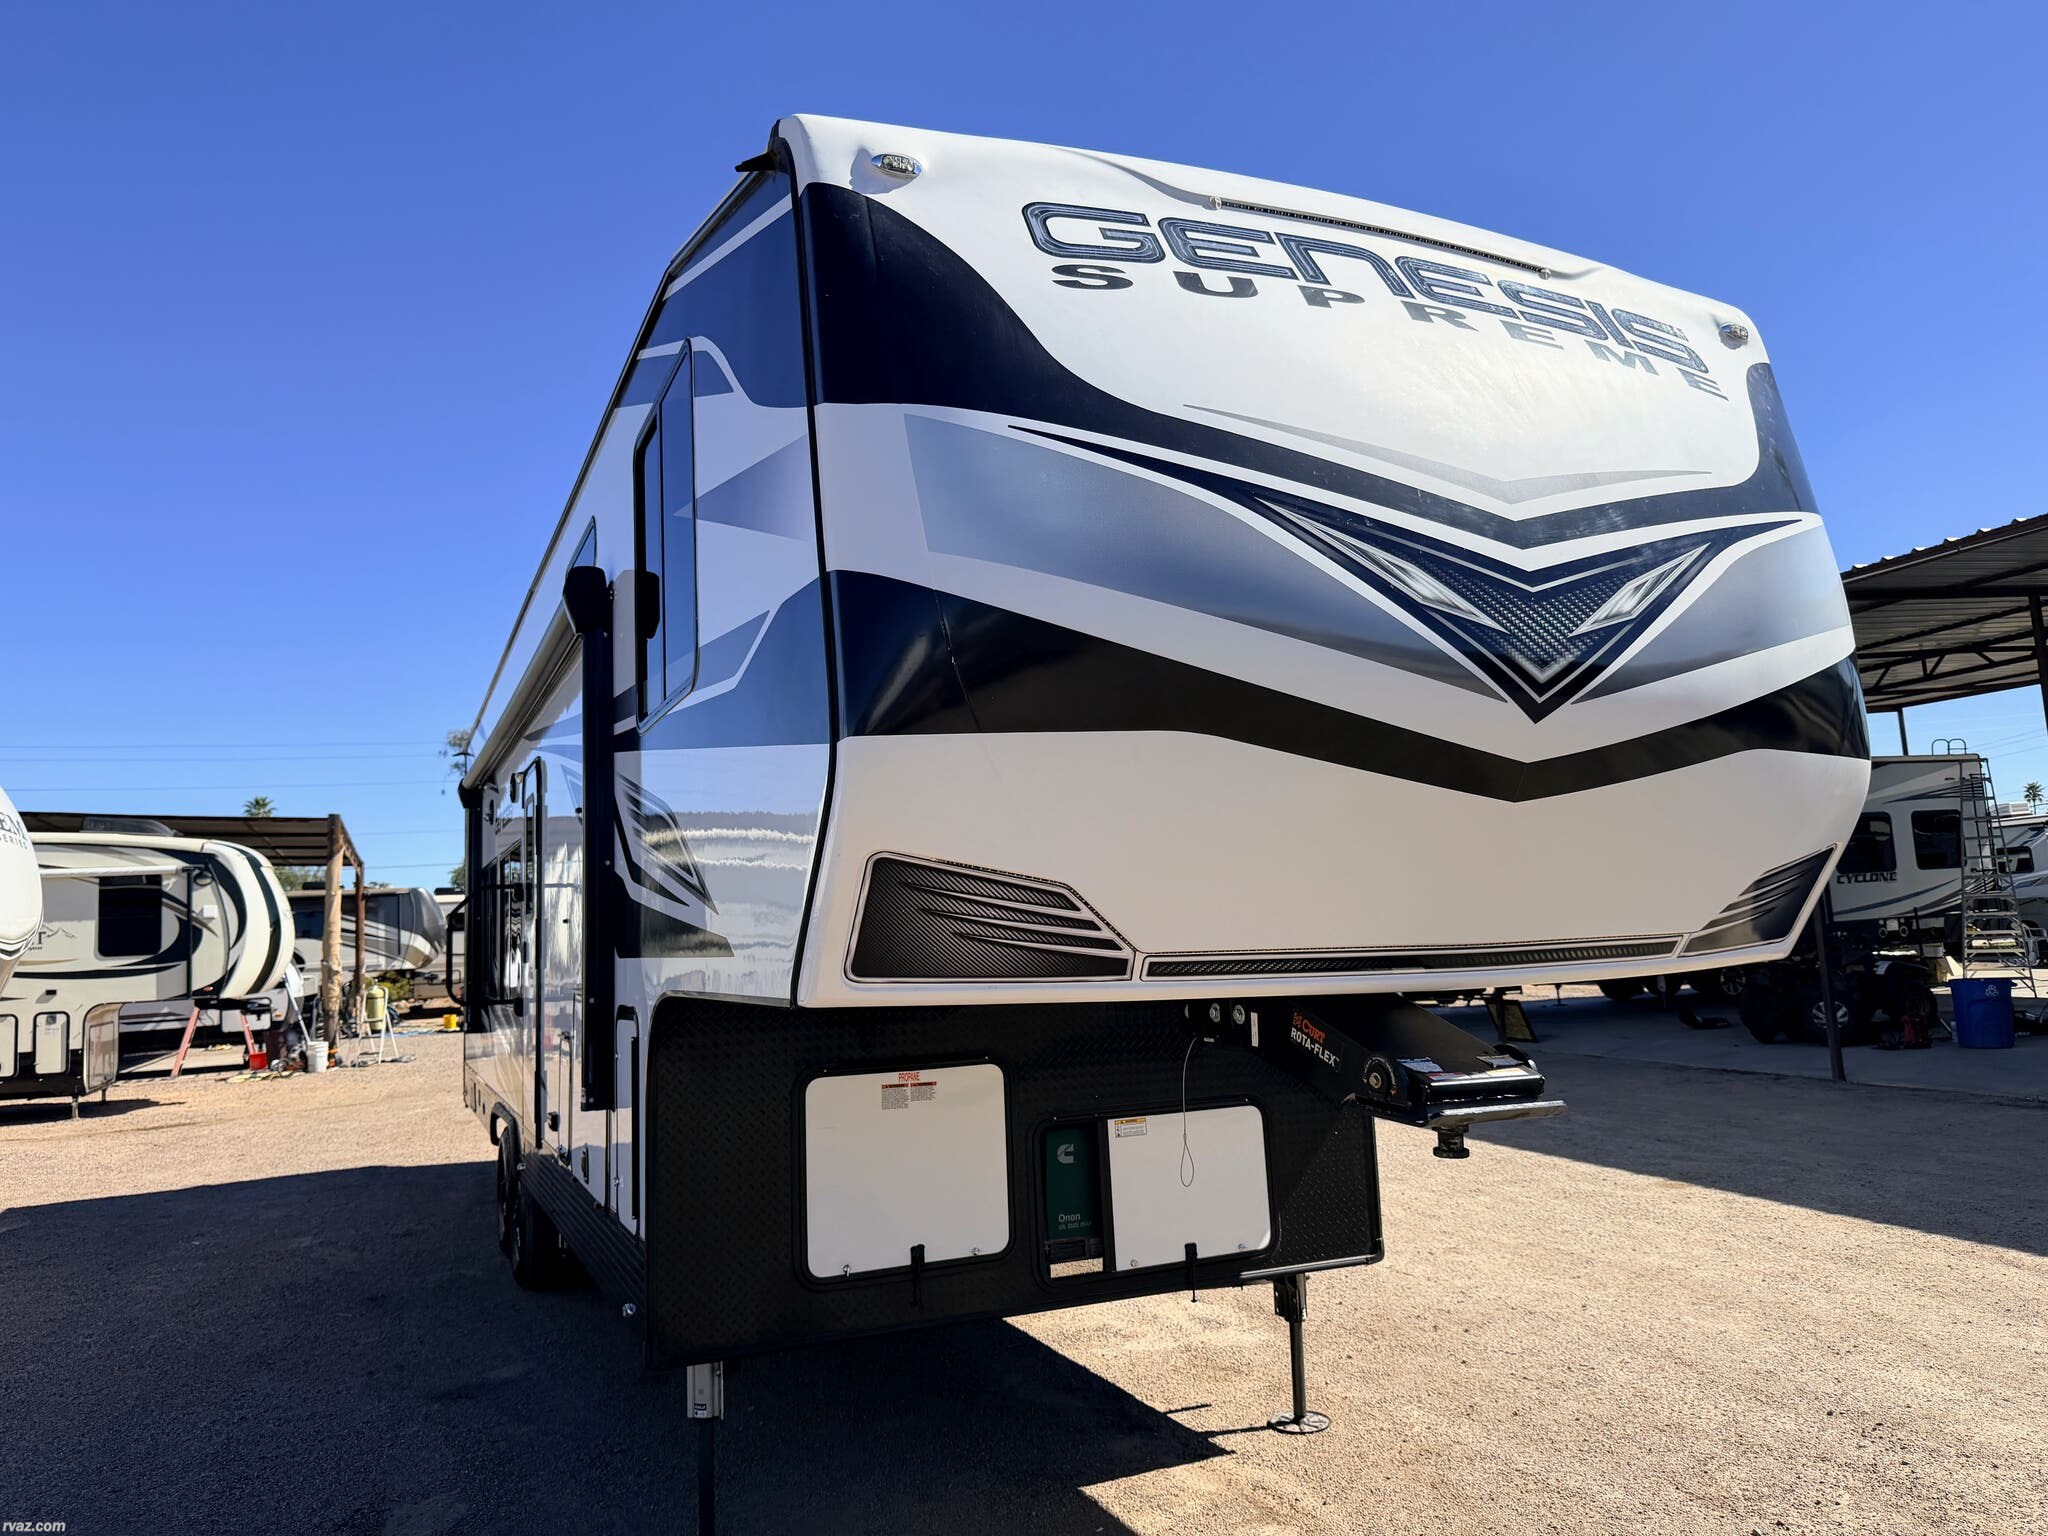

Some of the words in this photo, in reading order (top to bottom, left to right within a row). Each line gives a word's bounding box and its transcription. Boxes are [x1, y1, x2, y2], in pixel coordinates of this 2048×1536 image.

[1022, 201, 1710, 374] GENESIS
[1052, 264, 1730, 401] SUPREME
[1836, 871, 1897, 884] CYCLONE
[1302, 1019, 1326, 1044] CURT
[898, 1071, 920, 1082] PROPANE
